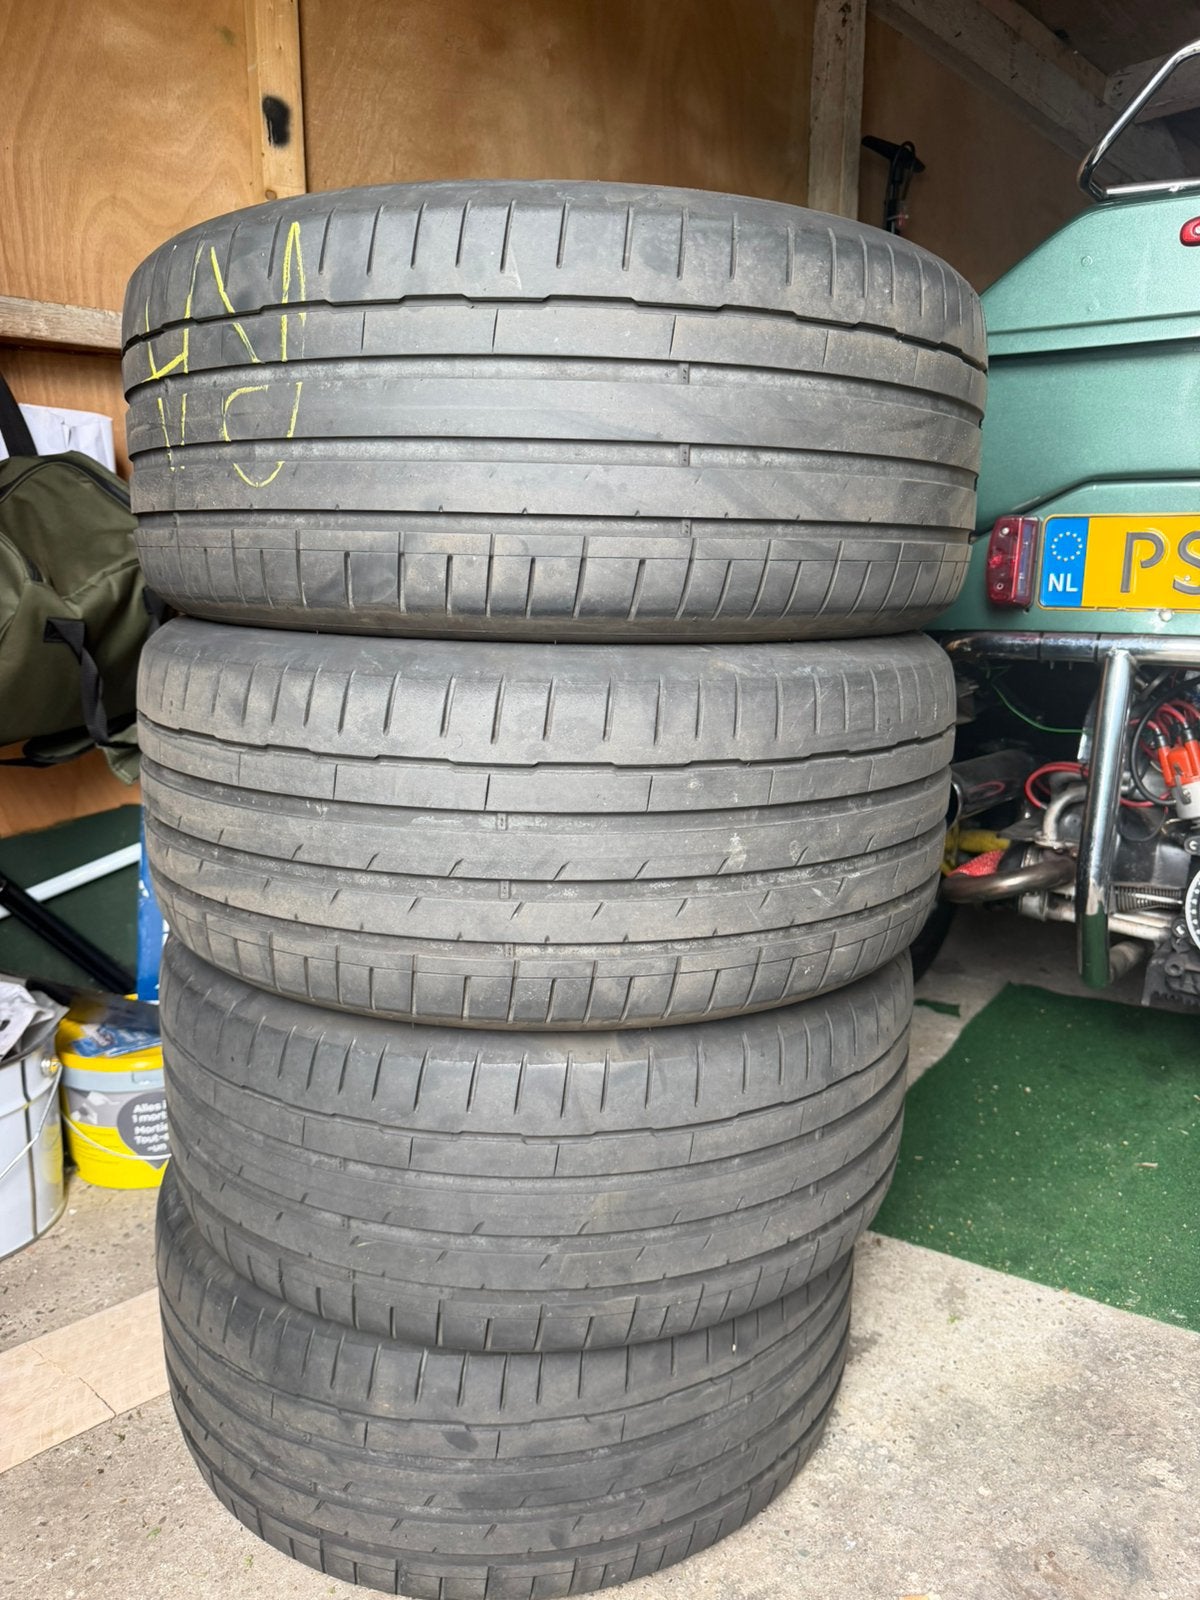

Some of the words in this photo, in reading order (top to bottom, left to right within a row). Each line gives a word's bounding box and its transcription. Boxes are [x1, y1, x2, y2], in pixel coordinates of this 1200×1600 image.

[1048, 573, 1078, 592] NL
[1120, 530, 1200, 595] PS
[133, 1102, 161, 1114] Alles
[138, 1110, 168, 1123] mort
[134, 1122, 169, 1135] Mortie
